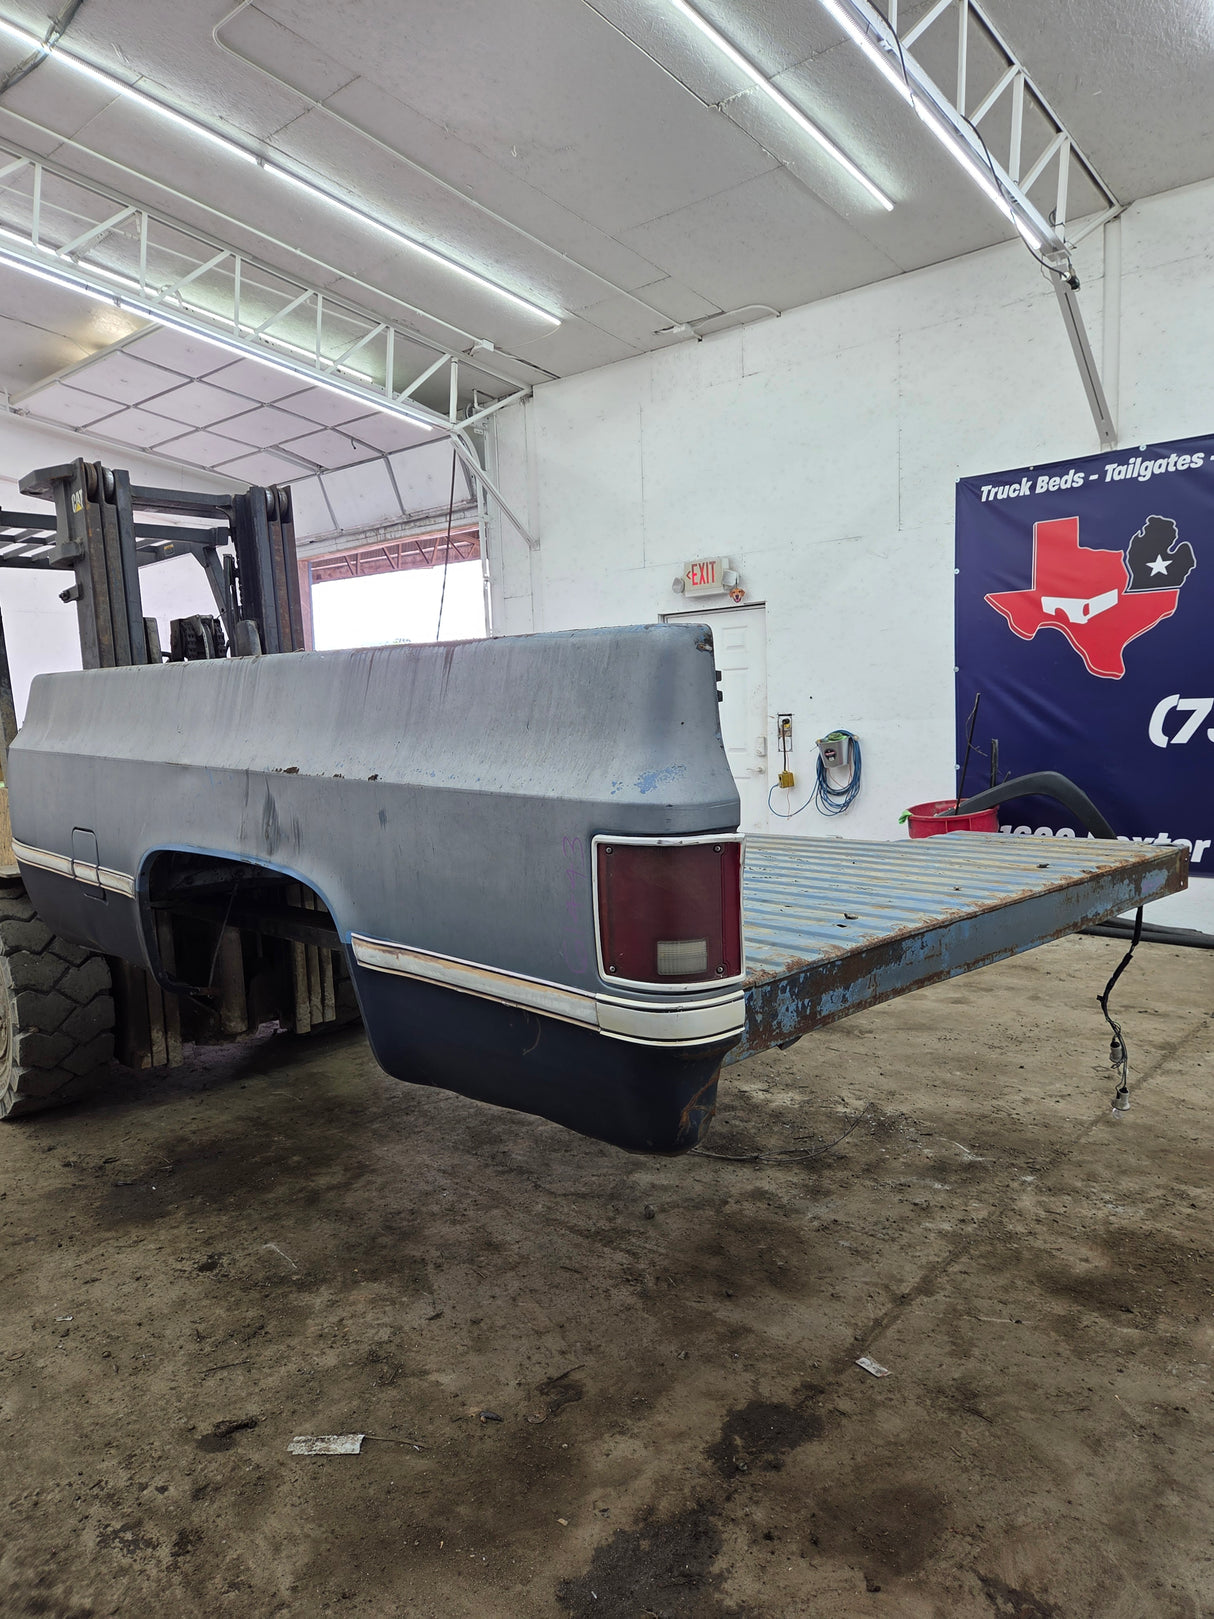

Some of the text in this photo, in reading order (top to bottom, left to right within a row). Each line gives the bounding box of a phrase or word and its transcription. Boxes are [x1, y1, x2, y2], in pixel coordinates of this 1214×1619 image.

[981, 478, 1032, 502] Truck
[1035, 469, 1085, 494] Beds
[1104, 451, 1205, 482] Tailgates
[71, 488, 83, 513] CAT
[691, 561, 716, 586] EXIT
[1148, 694, 1214, 748] (7
